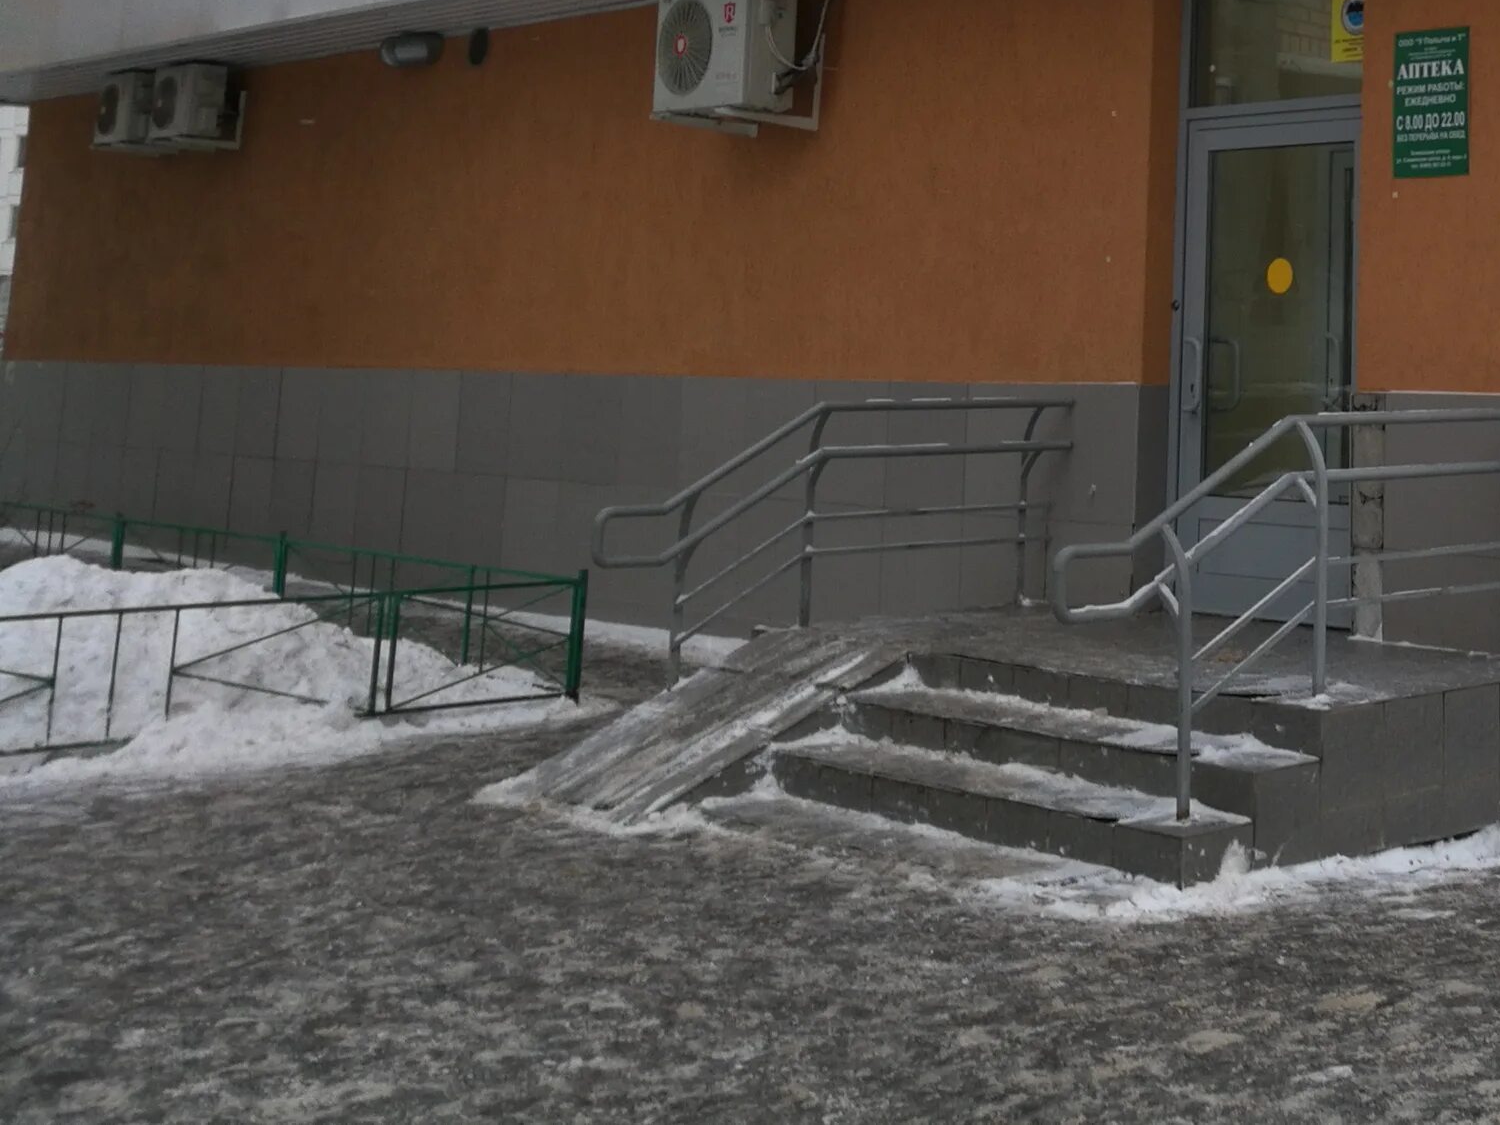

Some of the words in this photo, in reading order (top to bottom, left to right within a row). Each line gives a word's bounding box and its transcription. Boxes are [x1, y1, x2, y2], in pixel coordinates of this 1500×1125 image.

[1397, 58, 1464, 81] АПТЕКА
[1396, 84, 1426, 95] РЕЖИМ
[1404, 93, 1456, 107] ЕЖЕДНЕВНО
[1396, 115, 1404, 131] С
[1425, 113, 1440, 132] ДО
[1441, 110, 1466, 128] 22.00
